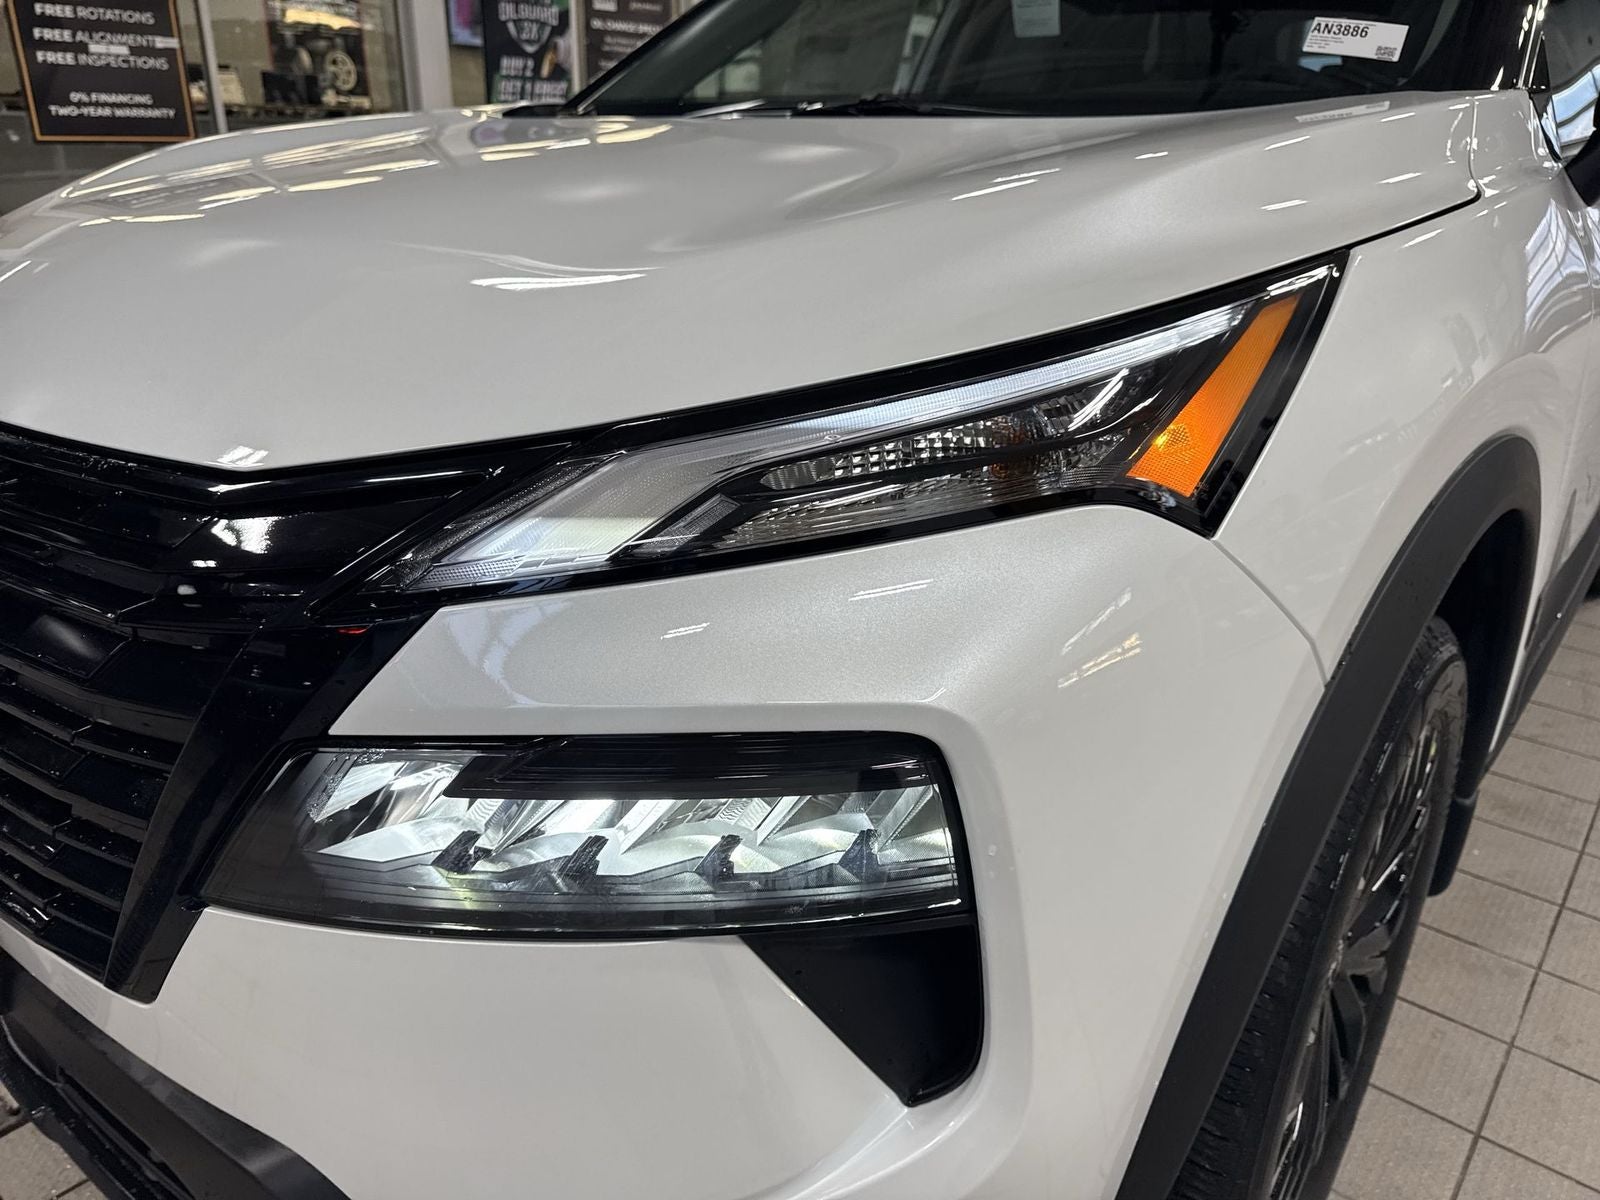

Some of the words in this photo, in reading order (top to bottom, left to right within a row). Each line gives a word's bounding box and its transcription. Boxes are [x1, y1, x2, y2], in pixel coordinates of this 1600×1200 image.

[34, 2, 75, 18] FREE
[76, 5, 156, 25] ROTATIONS
[32, 27, 73, 43] FREE
[1311, 23, 1370, 38] AN3886
[36, 51, 76, 66] FREE
[77, 53, 169, 71] INSPECTIONS
[90, 92, 154, 105] FINANCING
[48, 104, 113, 117] TWO-YEAR
[113, 106, 176, 119] WARRANTY
